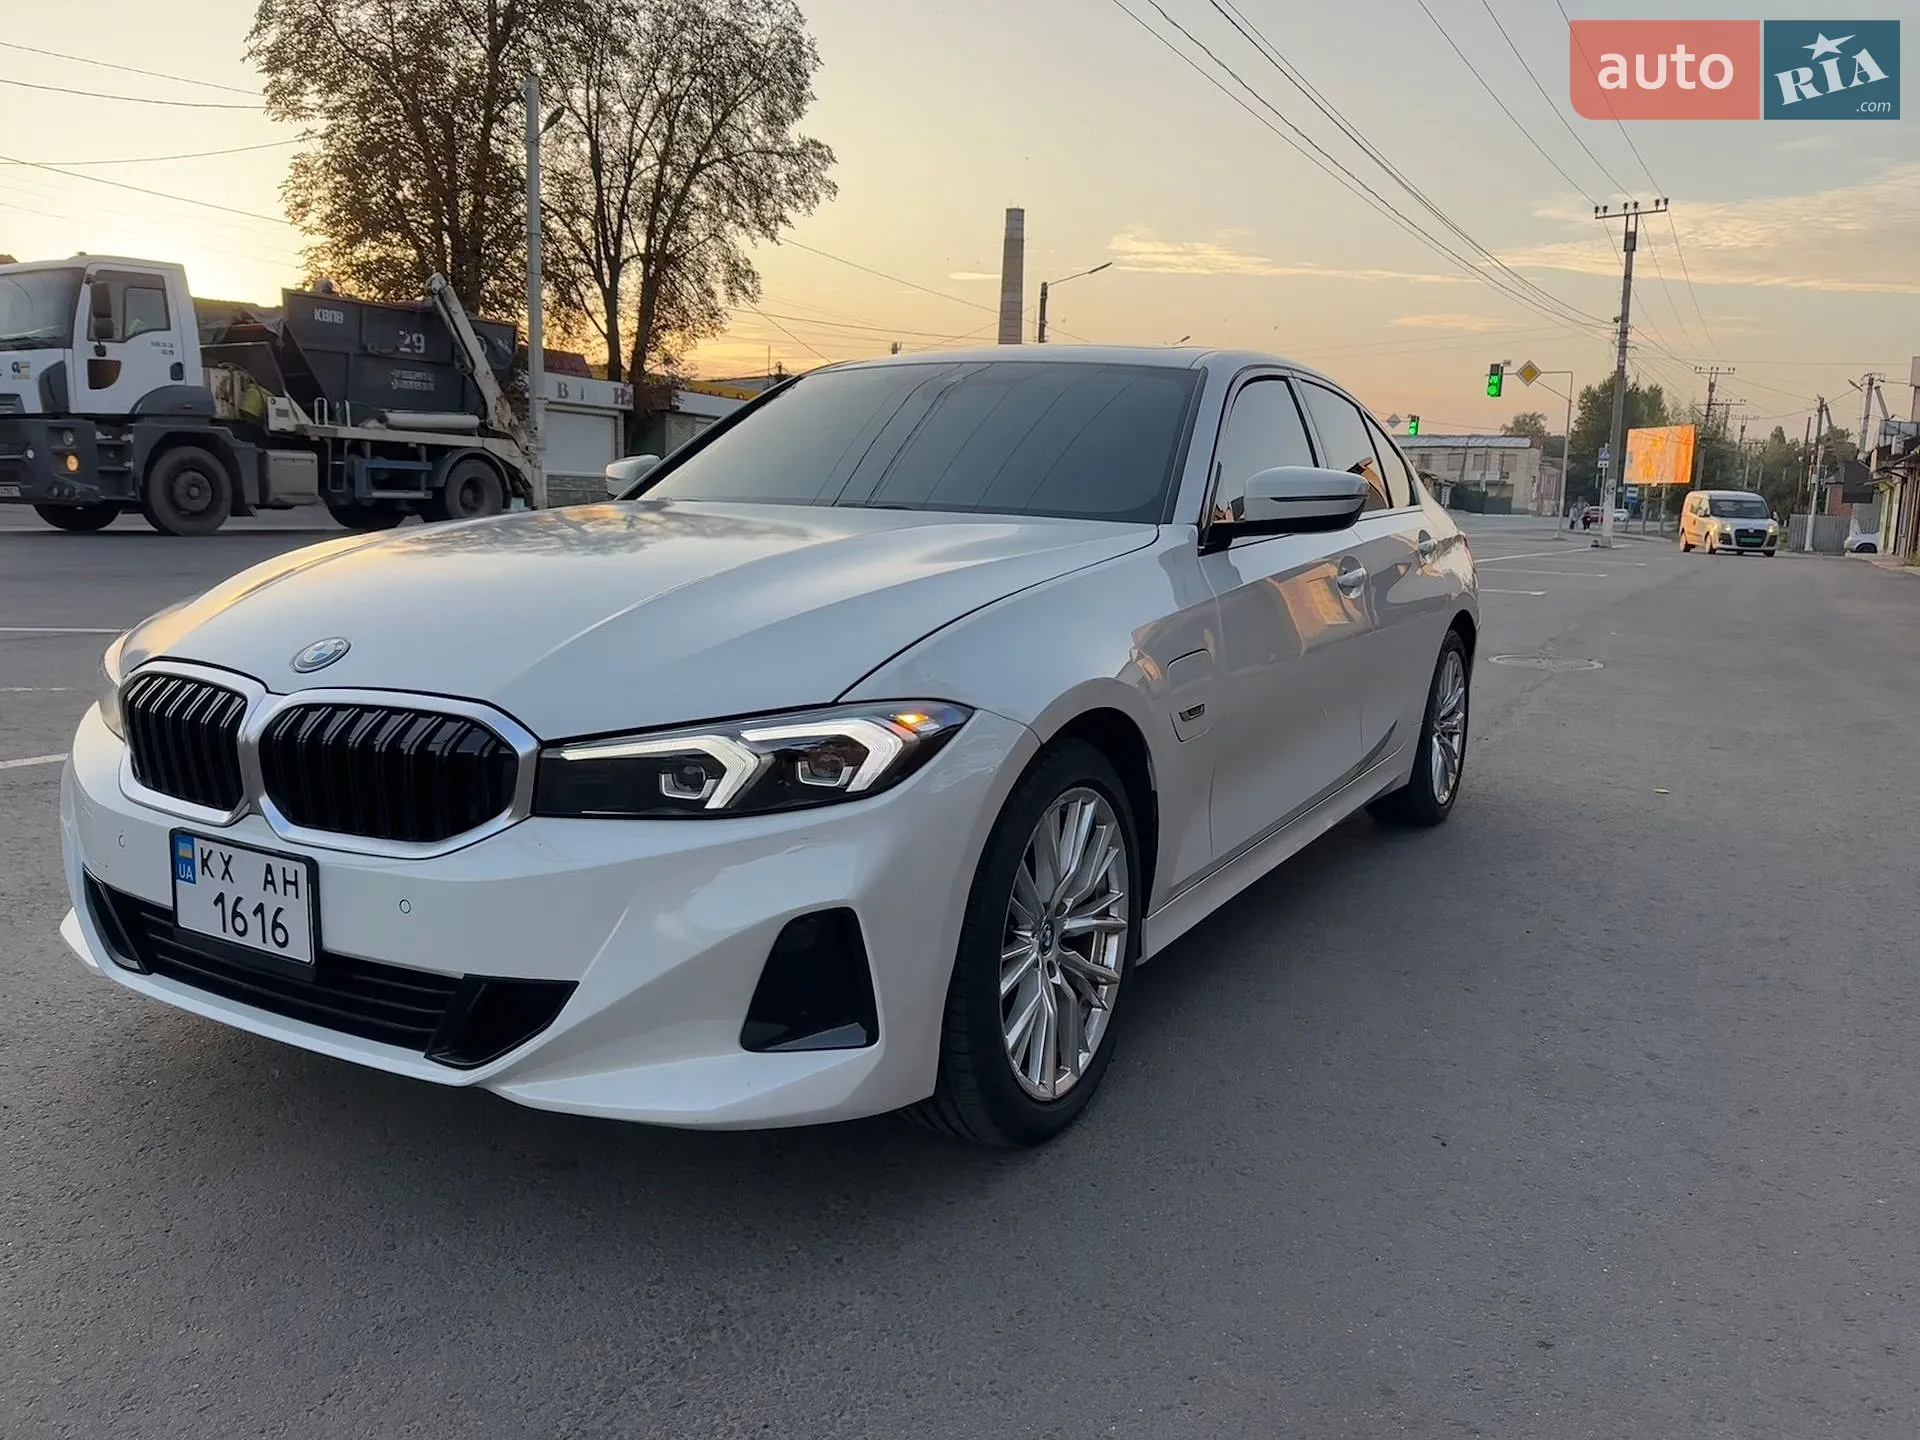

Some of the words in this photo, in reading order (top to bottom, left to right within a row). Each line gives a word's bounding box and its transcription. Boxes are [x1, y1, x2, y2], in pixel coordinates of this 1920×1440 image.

[398, 329, 425, 354] 29
[178, 863, 194, 881] UA
[200, 847, 234, 884] KX
[263, 863, 299, 899] AH
[213, 891, 289, 948] 1616
